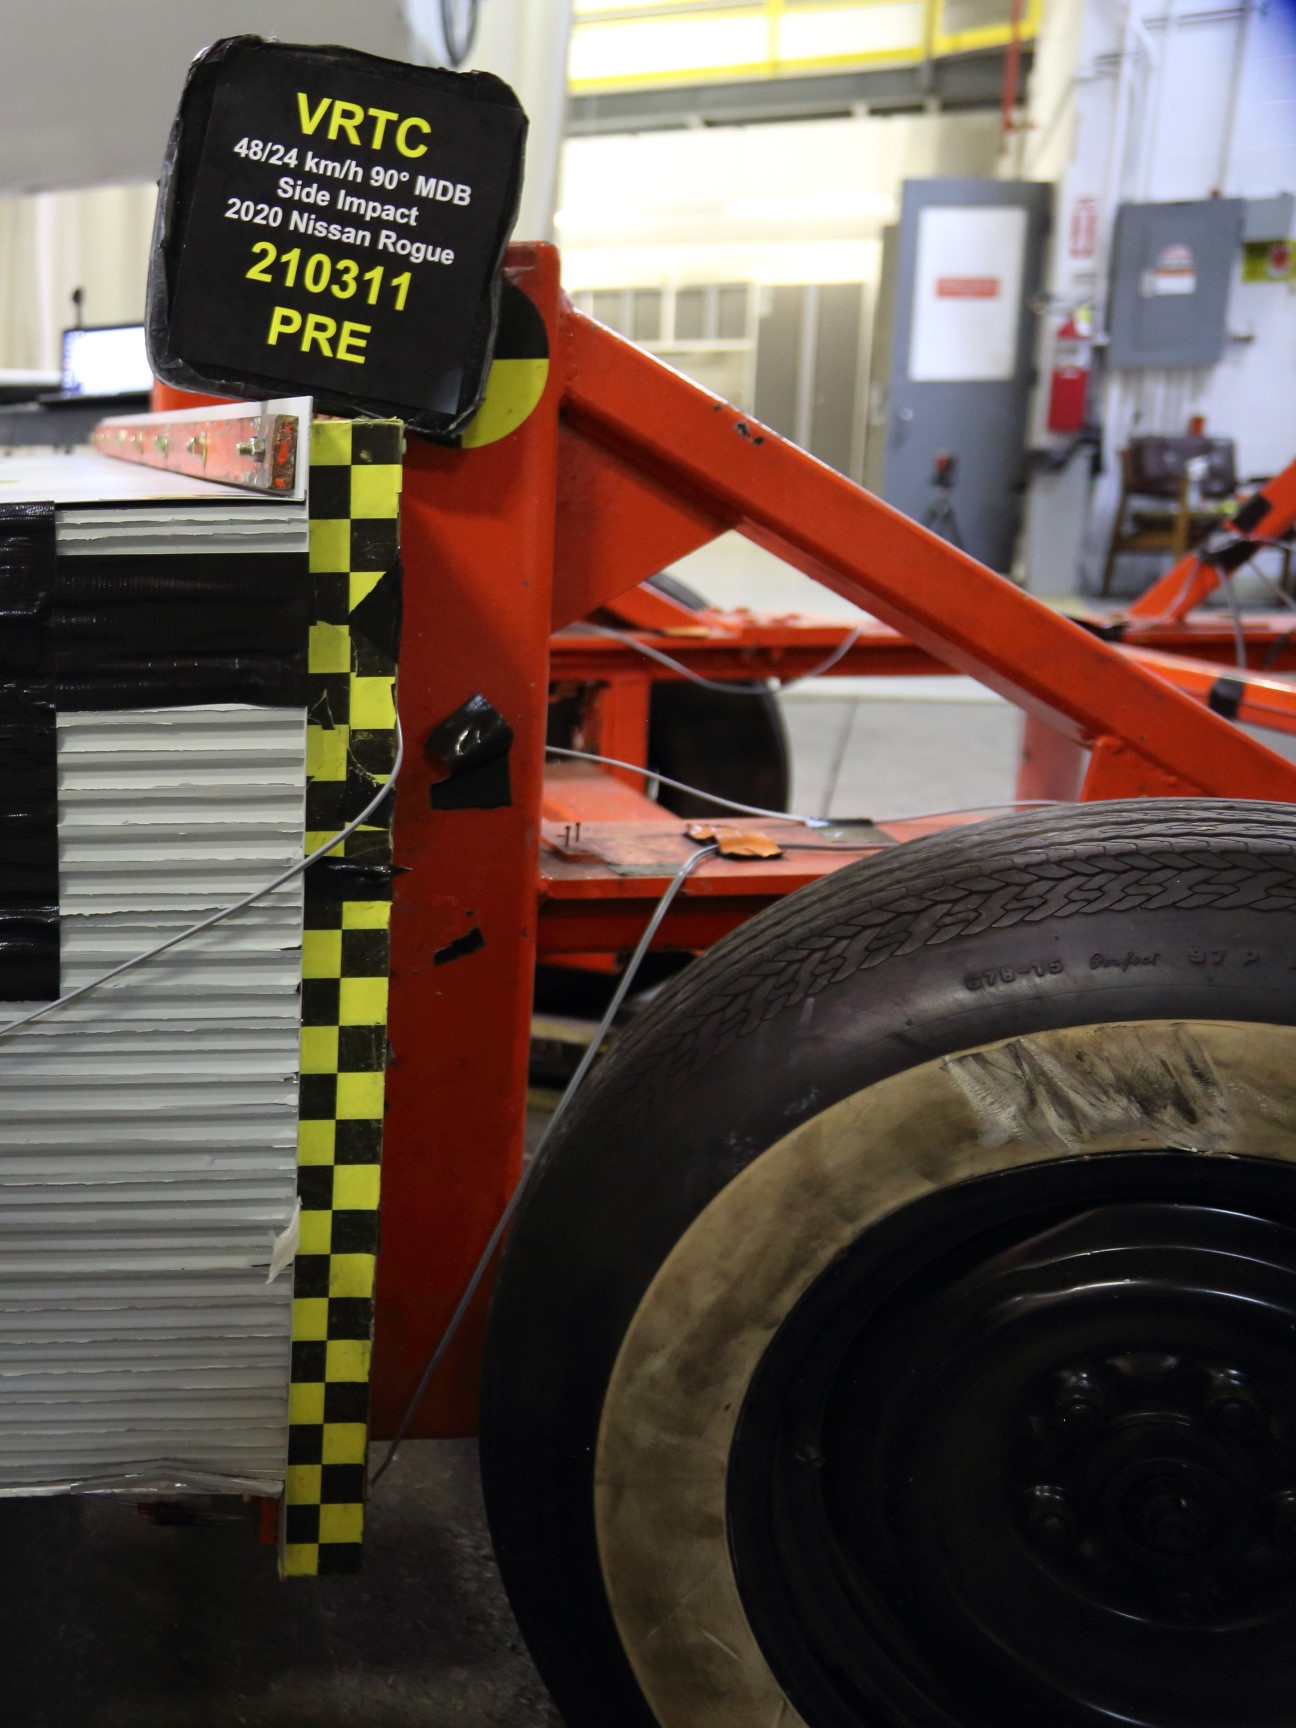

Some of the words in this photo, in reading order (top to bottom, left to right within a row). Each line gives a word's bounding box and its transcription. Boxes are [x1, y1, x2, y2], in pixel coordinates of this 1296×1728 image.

[297, 92, 431, 158] VRTC
[234, 137, 298, 168] 48/24
[305, 152, 363, 182] km/h
[370, 166, 410, 191] 90°
[414, 176, 472, 206] MDB
[277, 177, 331, 206] Side
[337, 189, 419, 226] Impact
[224, 198, 283, 228] 2020
[289, 210, 371, 247] Nissan
[377, 230, 455, 265] Rogue
[246, 241, 412, 311] 210311
[267, 305, 372, 364] PRE
